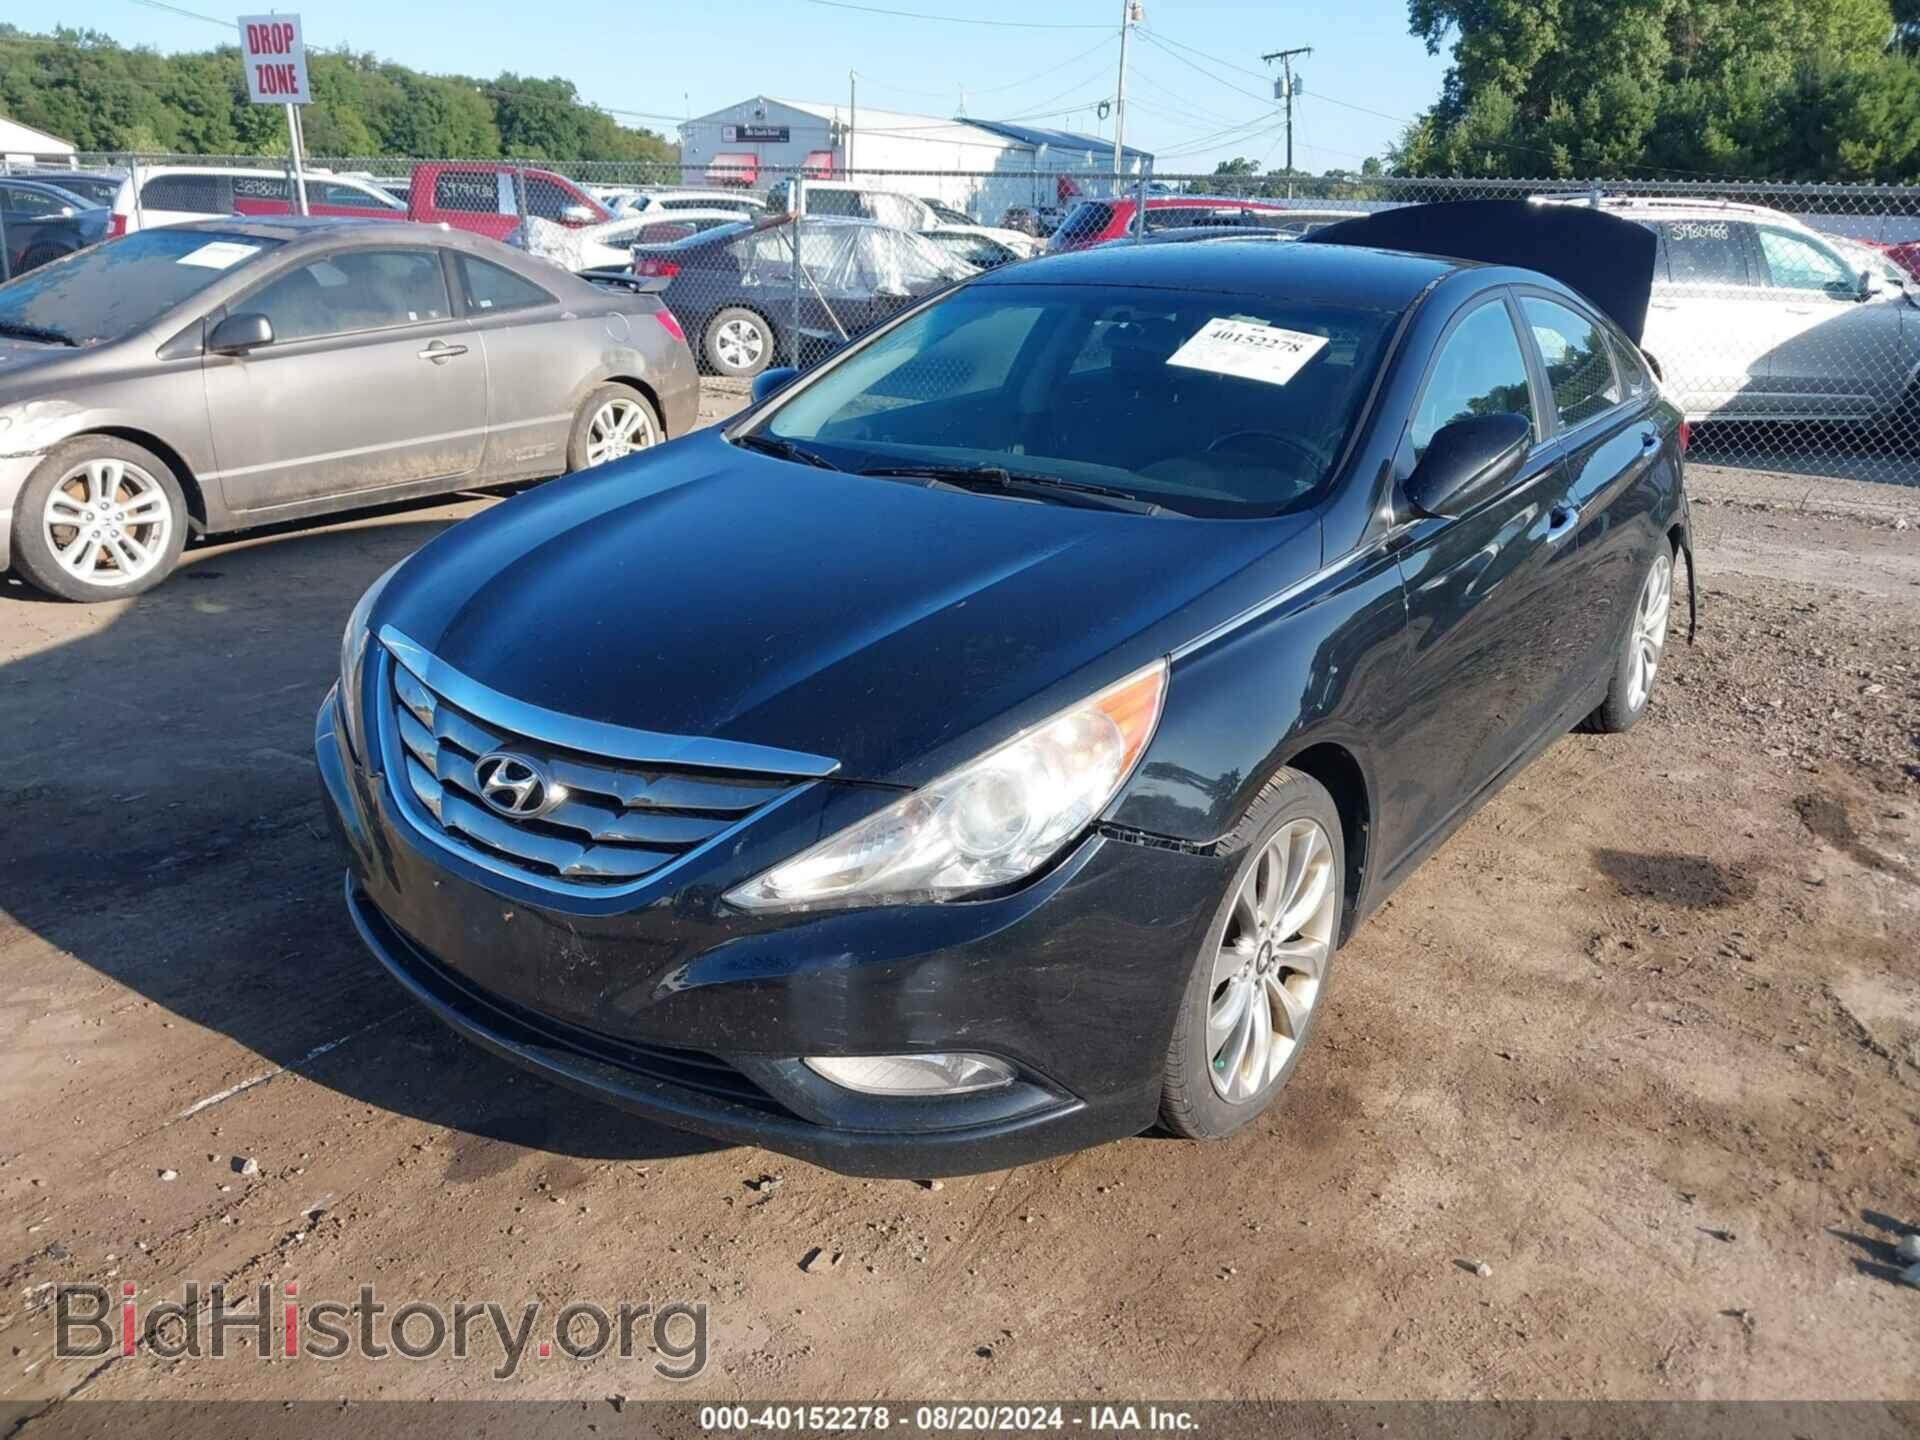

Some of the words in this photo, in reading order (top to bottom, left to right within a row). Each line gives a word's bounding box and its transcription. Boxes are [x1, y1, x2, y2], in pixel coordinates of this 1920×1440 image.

[247, 22, 294, 55] DROP
[256, 64, 299, 95] ZONE
[1210, 329, 1303, 352] 40152278
